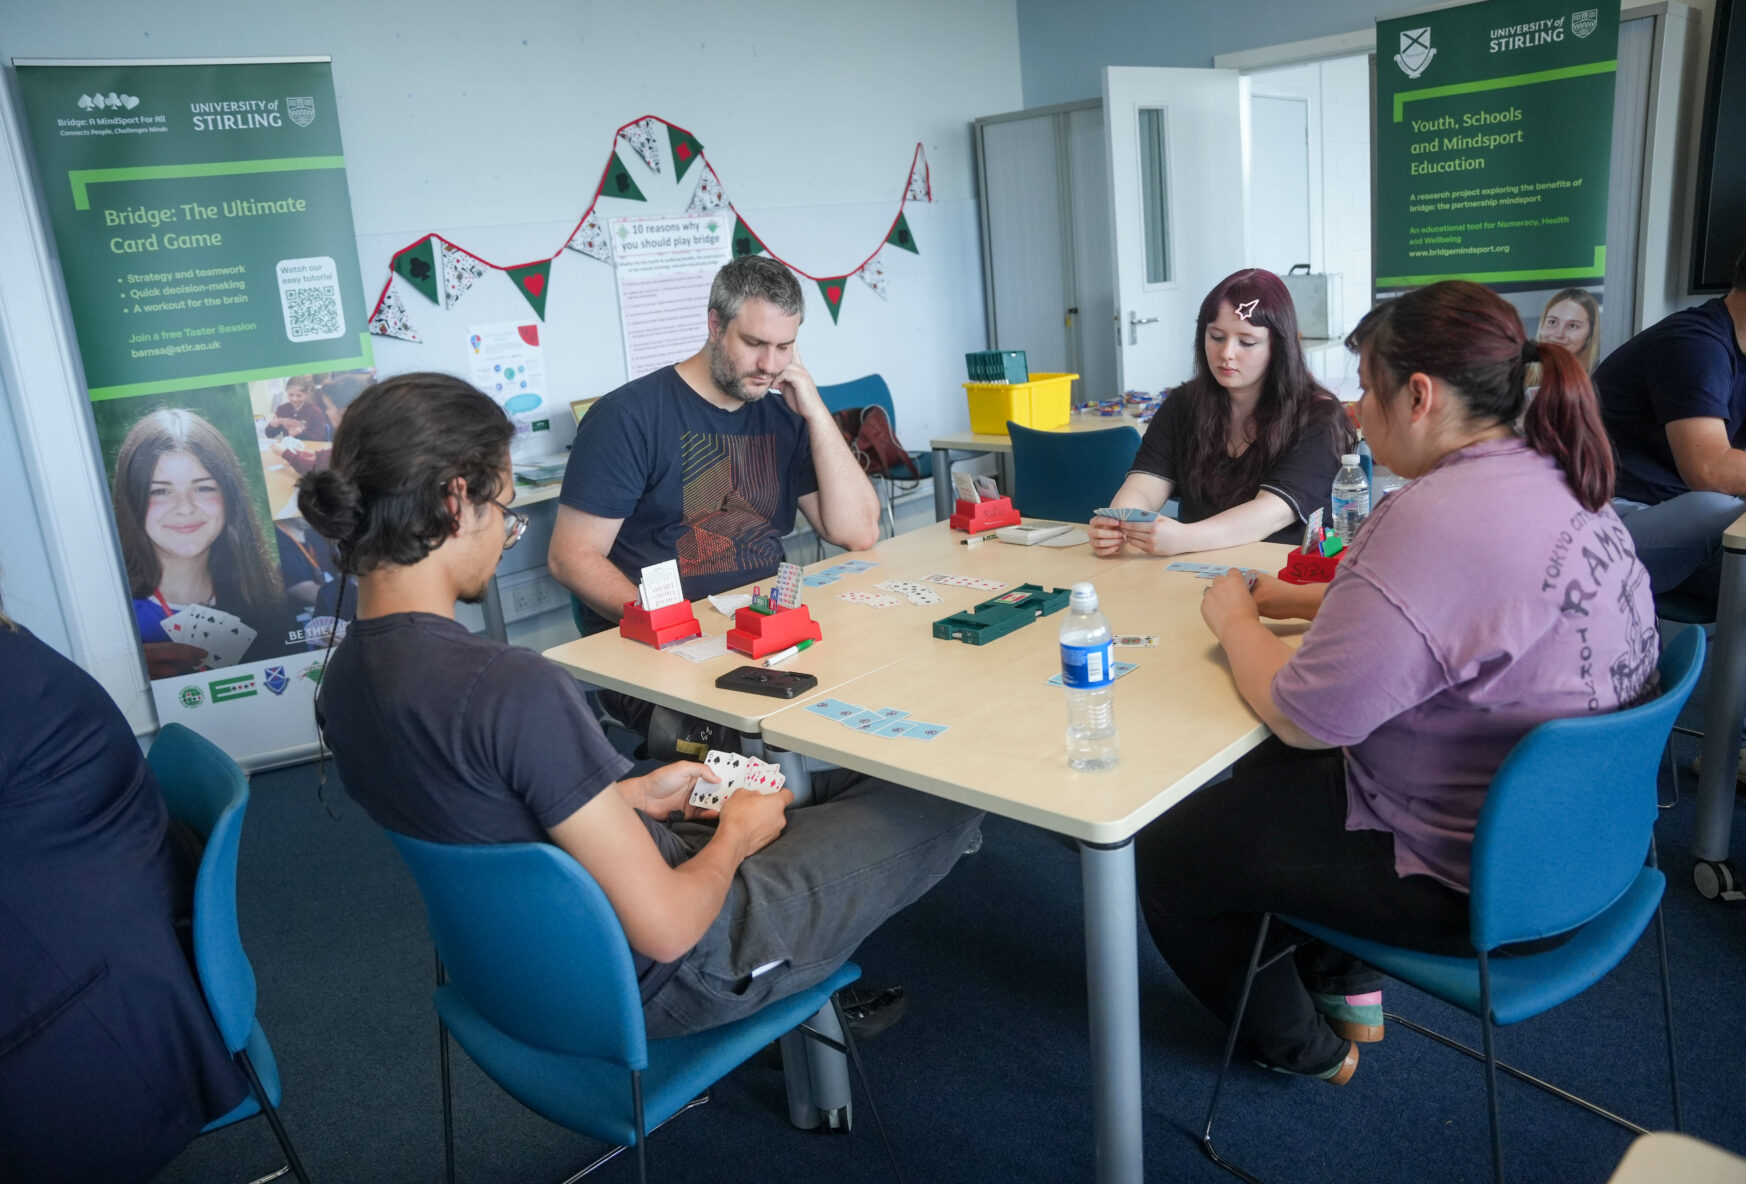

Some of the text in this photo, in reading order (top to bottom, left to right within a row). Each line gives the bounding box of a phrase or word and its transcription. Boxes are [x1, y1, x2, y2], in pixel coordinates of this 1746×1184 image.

[1490, 16, 1566, 39] UNIVERSITY of
[1489, 28, 1565, 53] STIRLING
[190, 99, 280, 113] UNIVERSITY of
[57, 118, 88, 128] Bridge:
[96, 116, 140, 126] MindSport
[140, 115, 153, 124] For
[154, 115, 166, 123] All
[193, 112, 283, 131] STIRLING
[1411, 107, 1522, 133] Youth, Schools
[1410, 128, 1524, 156] and Mindsport
[1410, 155, 1485, 176] Education
[1409, 178, 1583, 202] A research project exploring the benefits of
[104, 197, 307, 227] Bridge: The Ultimate
[1410, 194, 1542, 213] bridge: the partnership mindsport
[632, 221, 700, 235] 10 reasons why
[1409, 215, 1570, 235] An educational tool for Numeracy, Health
[109, 231, 223, 254] Card Game
[621, 234, 721, 252] you should play bridge
[1409, 234, 1462, 246] and Wellbeing
[1409, 245, 1510, 258] www.bridgemindsport.org
[127, 265, 246, 284] Strategy and teamwork
[280, 263, 323, 275] Watch our
[282, 272, 334, 286] easy tutorial
[130, 280, 246, 300] Quick decision-making
[133, 294, 249, 314] A workout for the brain
[130, 333, 151, 344] Join
[153, 333, 160, 341] a
[161, 329, 183, 340] free
[218, 321, 257, 334] Session
[131, 340, 222, 359] bamsa@stir.ac.uk
[1542, 530, 1574, 593] TOKYO
[288, 629, 304, 641] BE
[307, 625, 328, 637] THE
[1576, 627, 1599, 712] TOKYO
